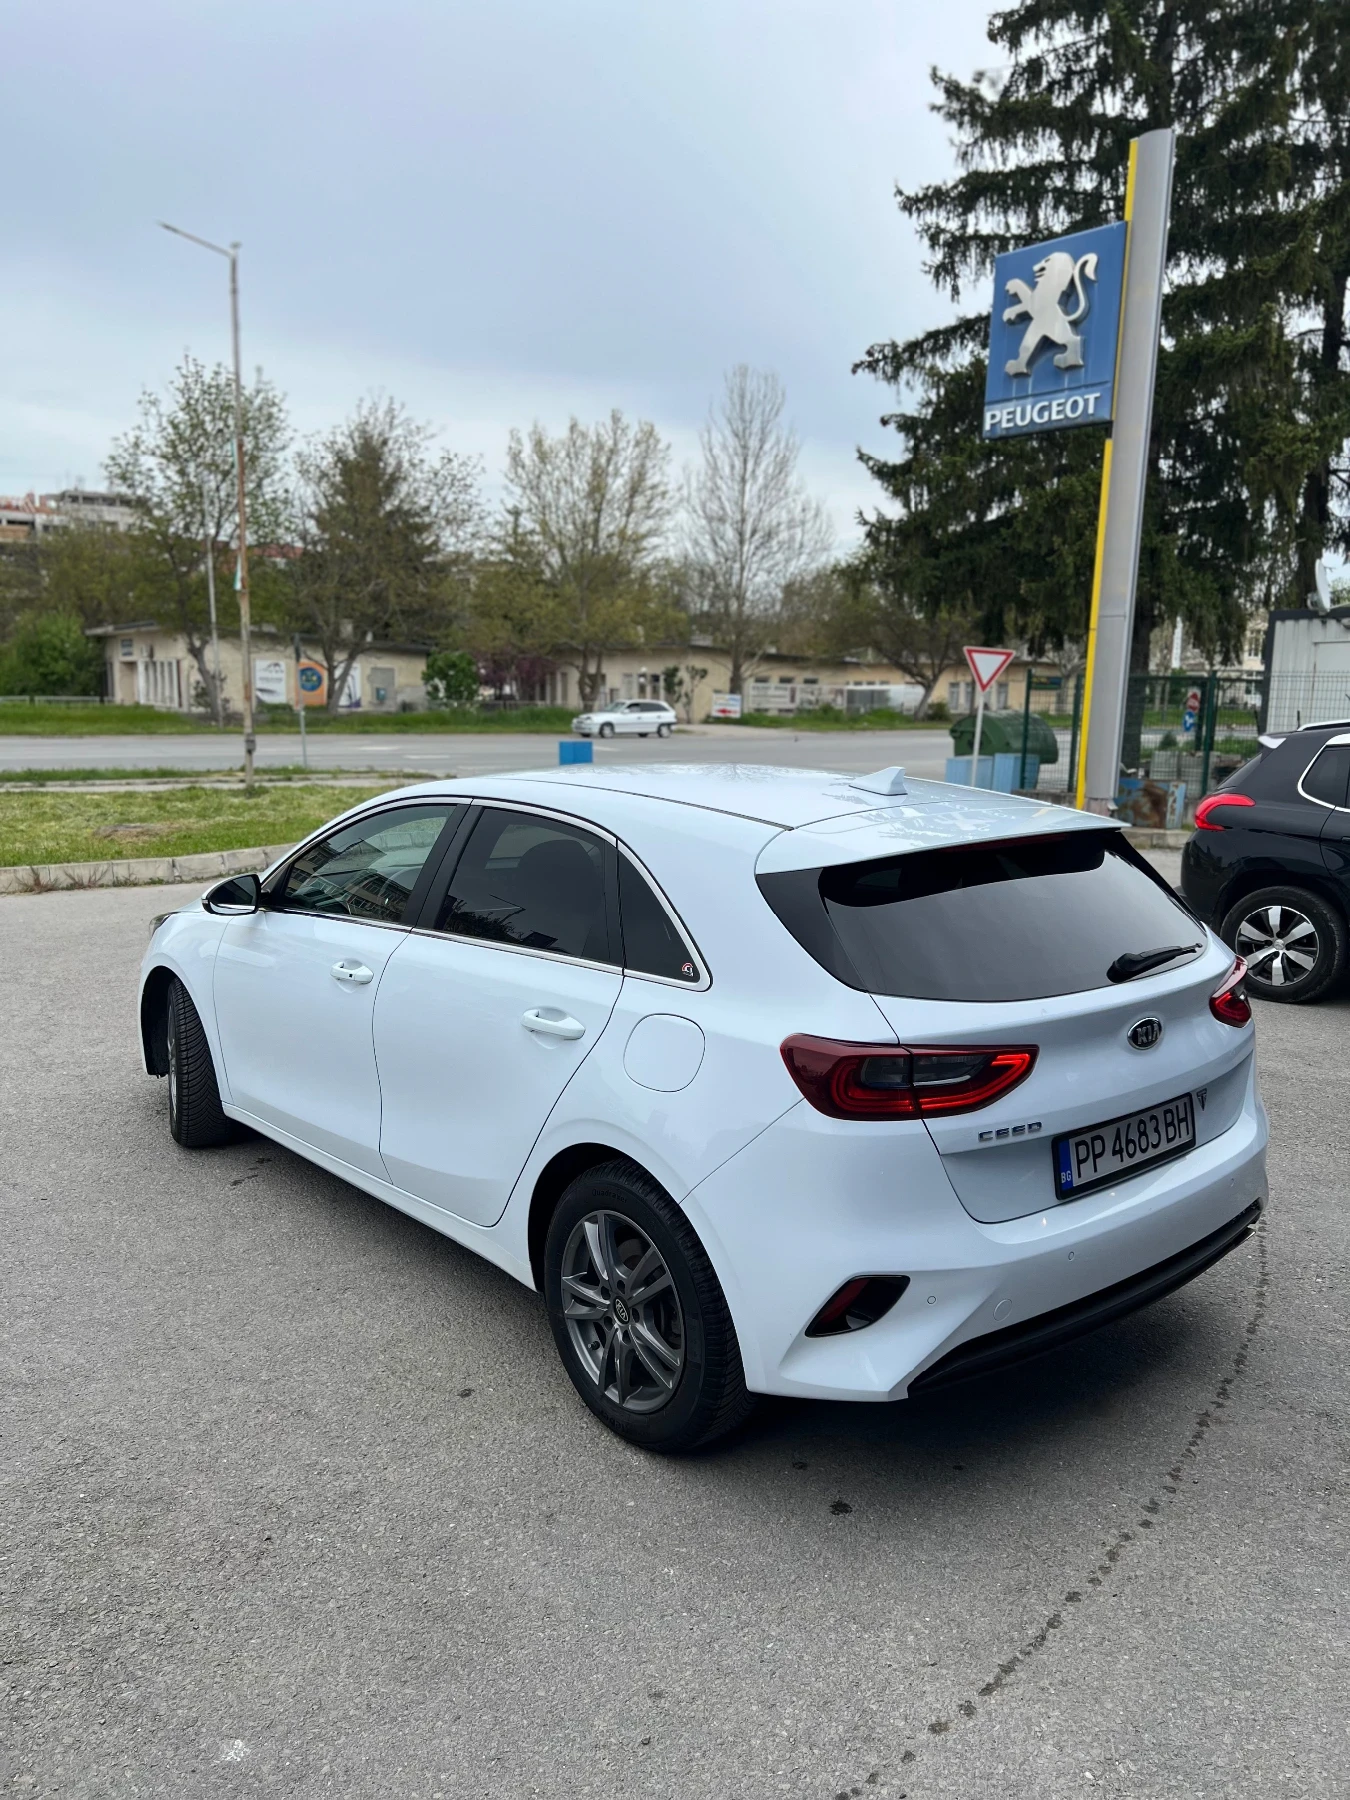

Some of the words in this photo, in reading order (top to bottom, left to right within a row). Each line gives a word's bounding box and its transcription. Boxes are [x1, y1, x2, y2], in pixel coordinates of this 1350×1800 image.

[985, 393, 1101, 431] PEUGEOT
[1136, 1023, 1160, 1045] KIA
[978, 1121, 1042, 1141] CEED
[1075, 1134, 1105, 1178] PP
[1112, 1114, 1161, 1163] 4683
[1163, 1102, 1189, 1145] BH
[1061, 1171, 1072, 1183] BG
